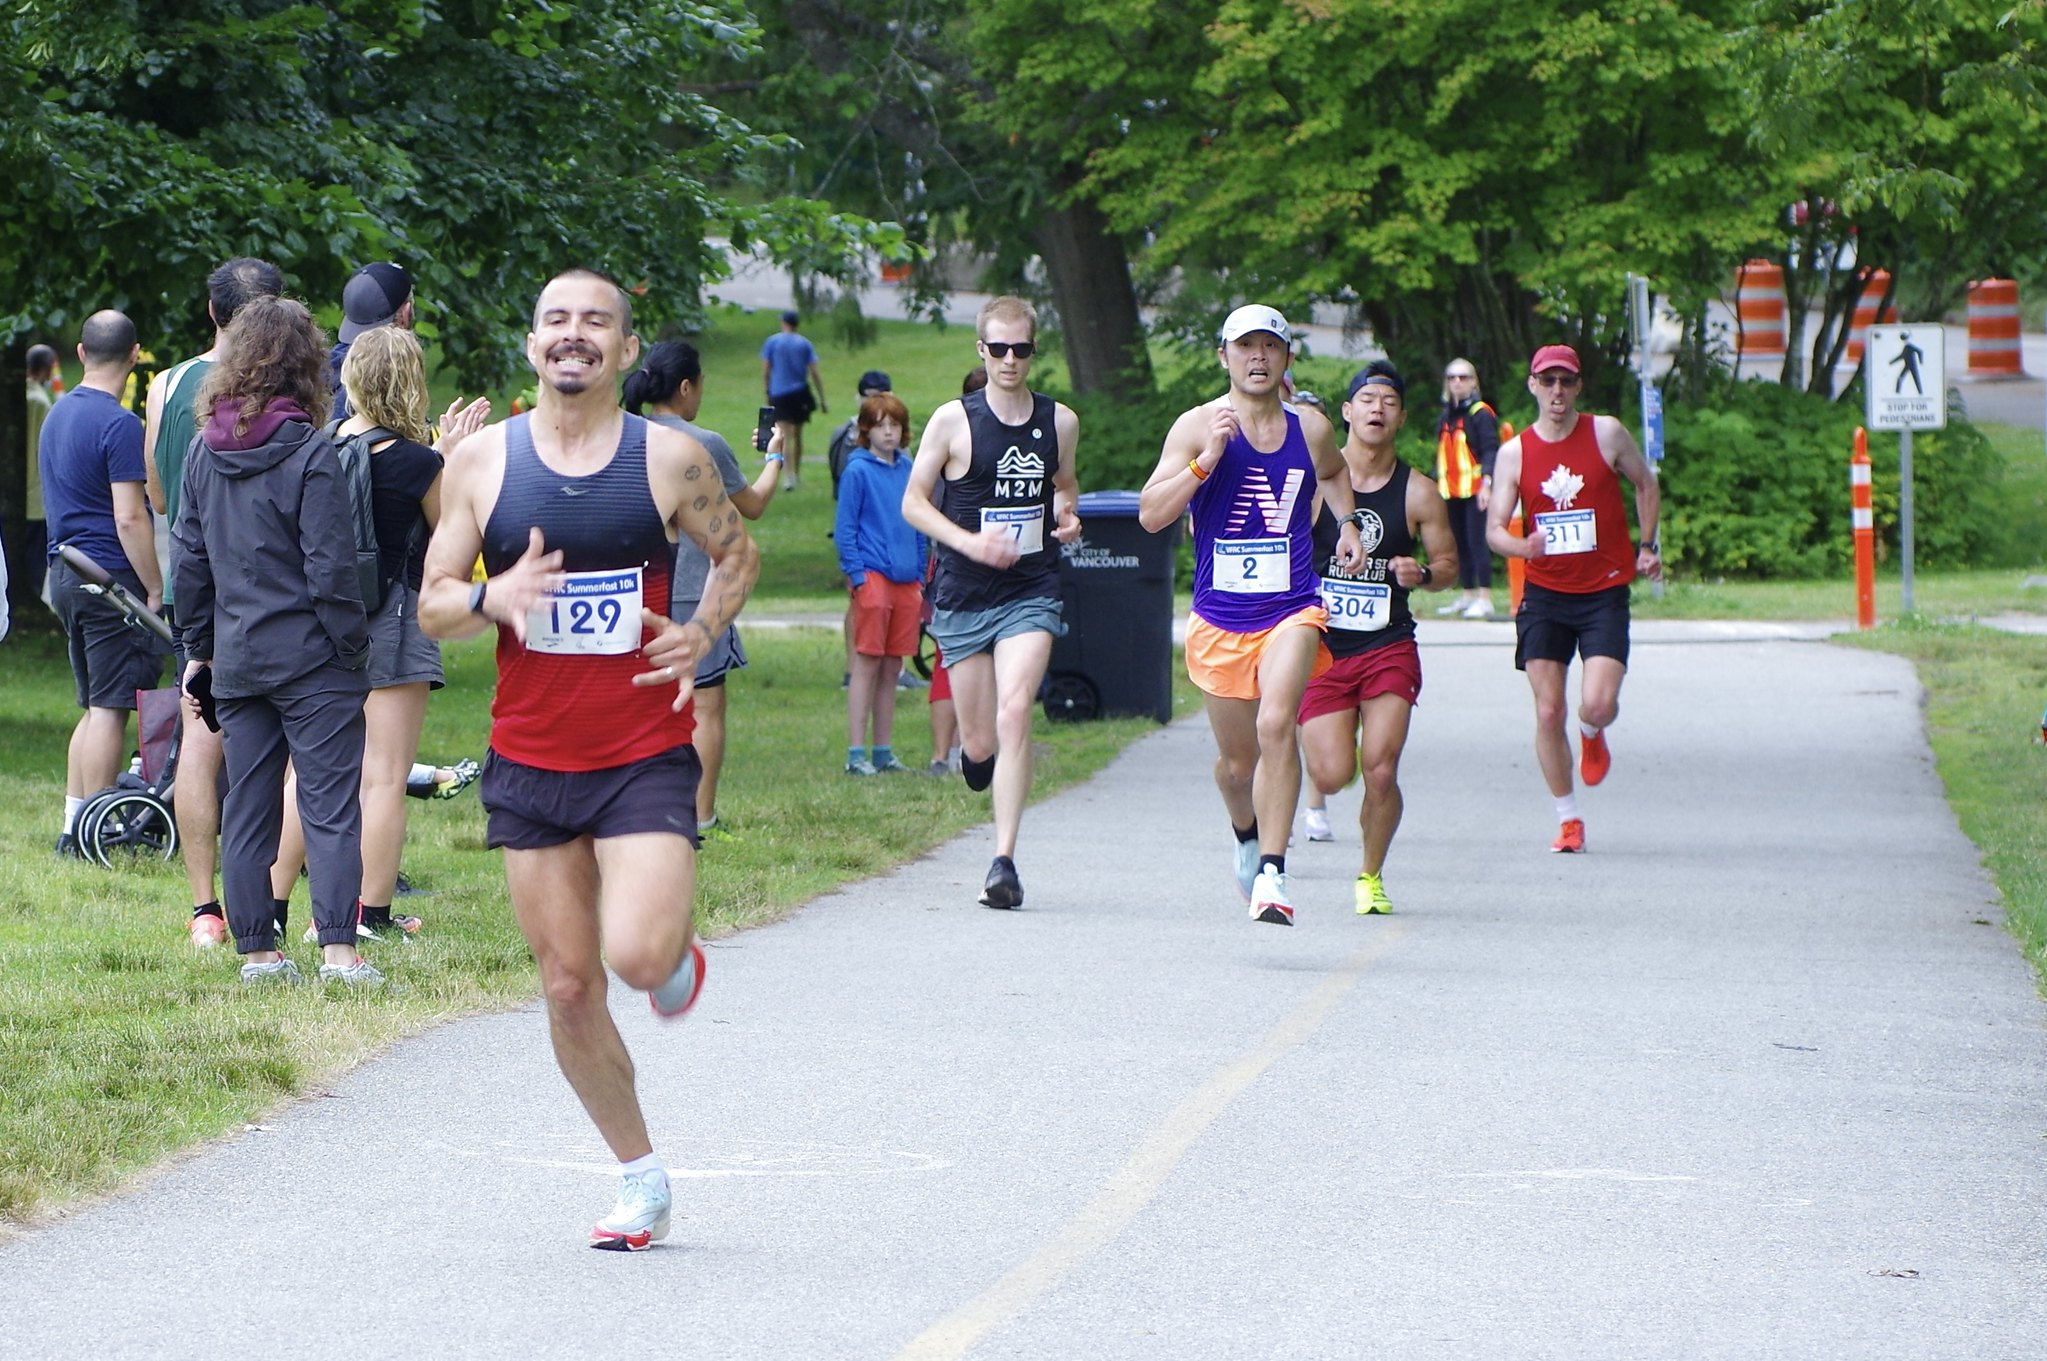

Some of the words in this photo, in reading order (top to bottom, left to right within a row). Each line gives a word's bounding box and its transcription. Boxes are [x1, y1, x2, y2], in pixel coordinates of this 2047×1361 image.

[1911, 403, 1928, 411] FOR
[1011, 523, 1023, 543] 7
[1546, 524, 1581, 543] 311
[1071, 556, 1139, 568] VANCOUVER
[1242, 556, 1258, 579] 2
[619, 579, 634, 590] 10k
[551, 599, 621, 634] 129
[1331, 596, 1375, 619] 304
